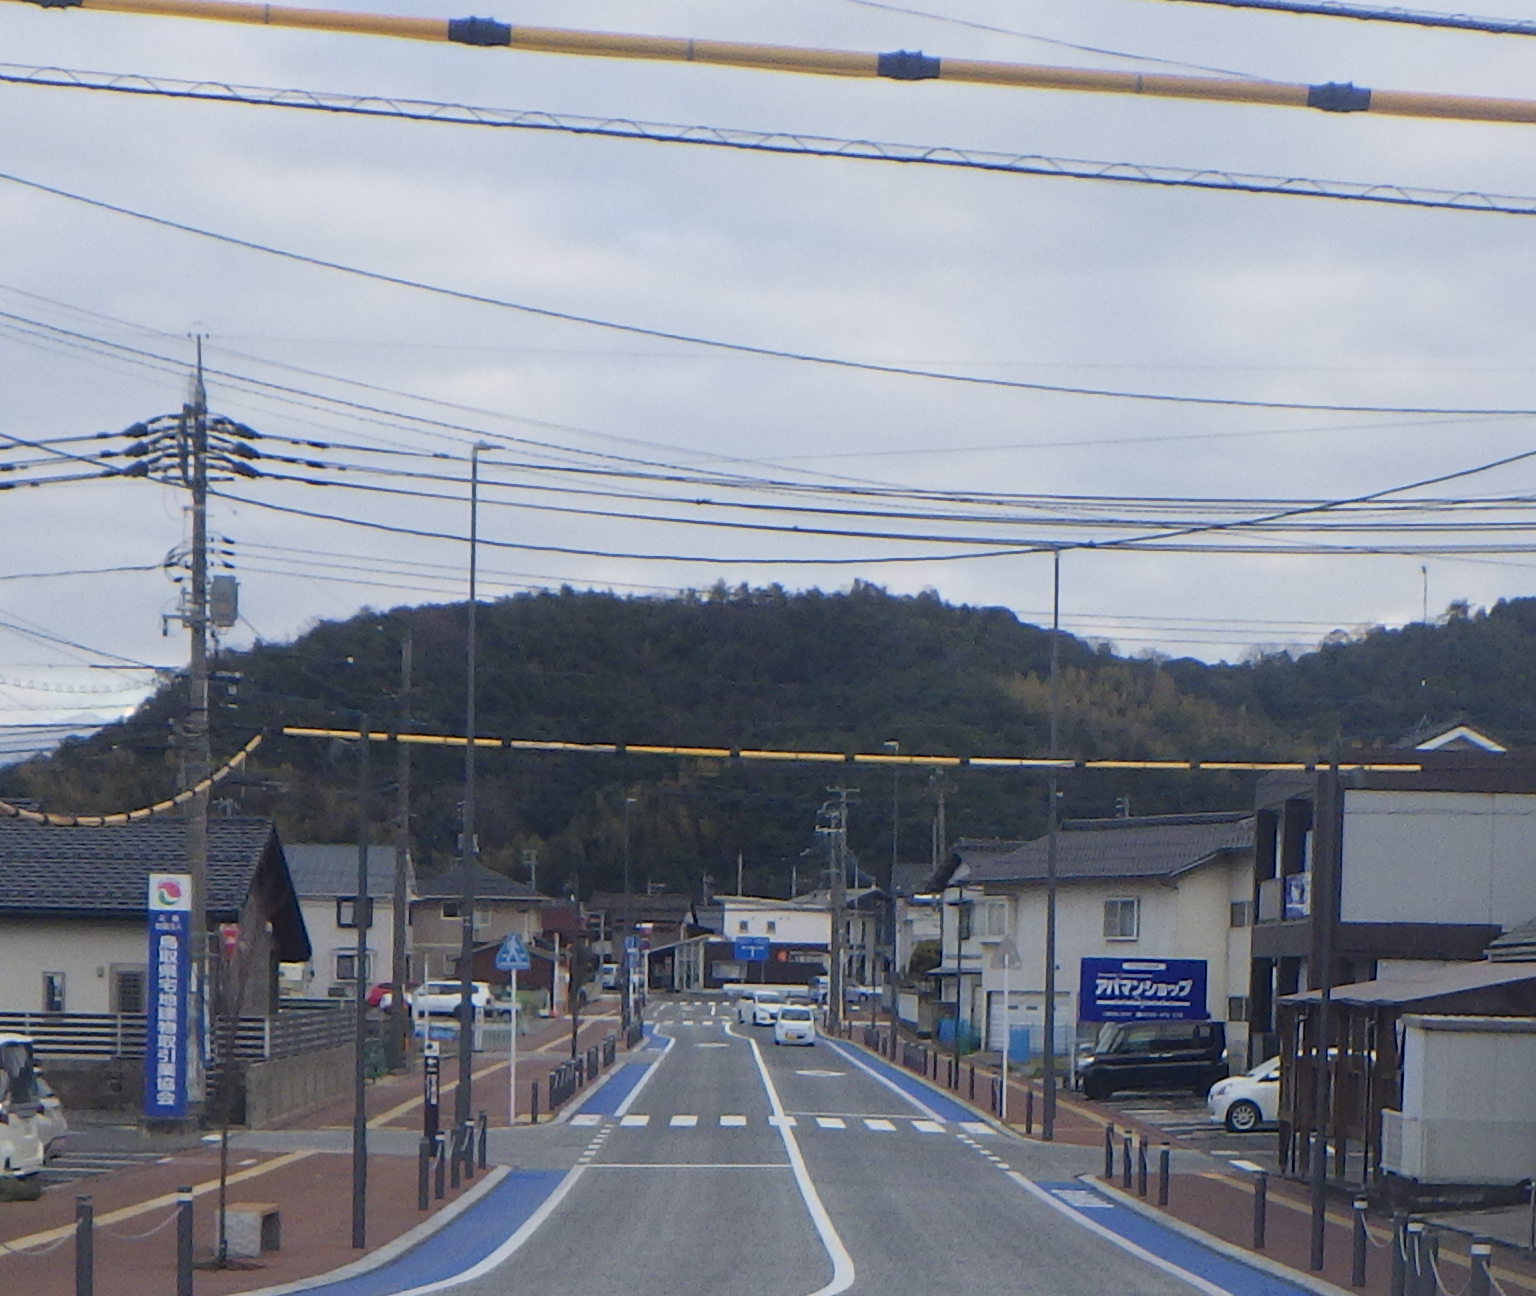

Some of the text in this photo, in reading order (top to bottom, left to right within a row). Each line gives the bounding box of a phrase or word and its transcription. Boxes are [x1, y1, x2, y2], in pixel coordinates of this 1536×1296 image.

[1095, 978, 1193, 997] アパマンショップ
